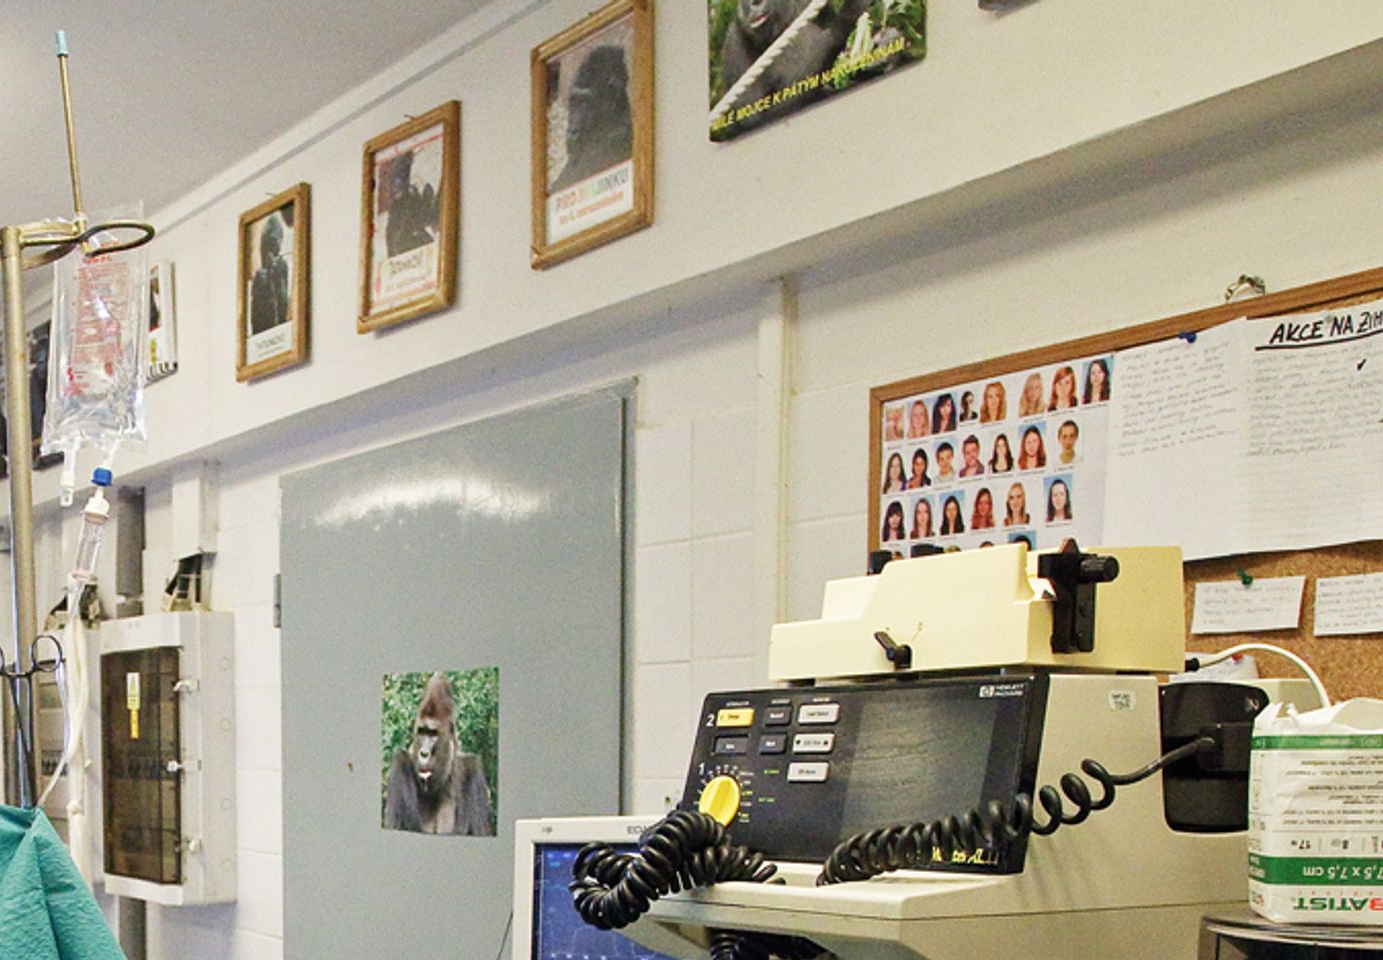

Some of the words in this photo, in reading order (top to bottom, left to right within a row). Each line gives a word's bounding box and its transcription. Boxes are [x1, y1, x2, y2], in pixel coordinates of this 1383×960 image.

[1269, 320, 1323, 344] AKCE
[1330, 314, 1354, 337] NA
[706, 713, 715, 727] 2
[699, 762, 705, 776] 1
[1302, 866, 1324, 877] cm
[1327, 864, 1348, 880] 7,5
[1293, 896, 1383, 912] BATIST
